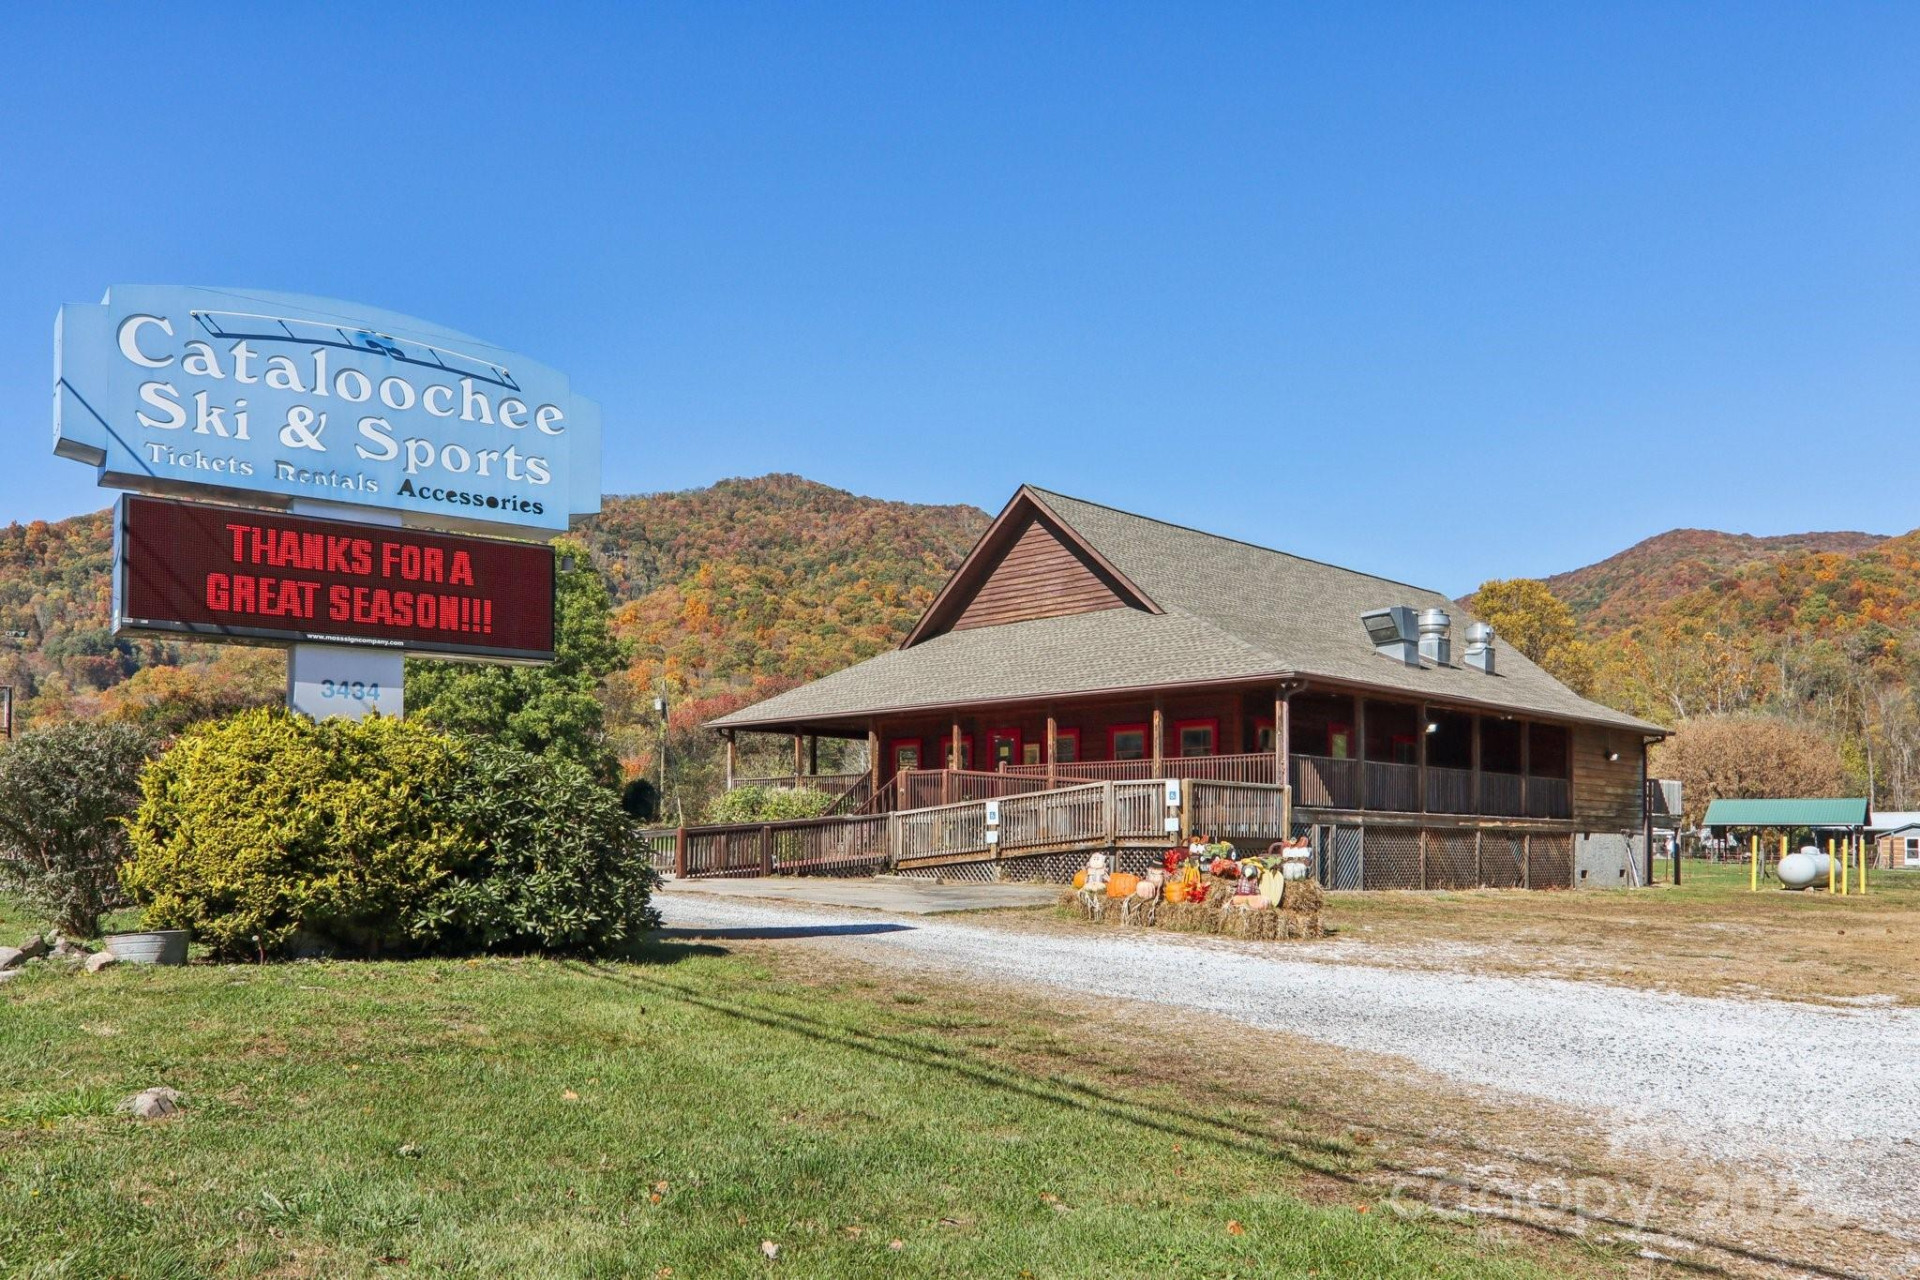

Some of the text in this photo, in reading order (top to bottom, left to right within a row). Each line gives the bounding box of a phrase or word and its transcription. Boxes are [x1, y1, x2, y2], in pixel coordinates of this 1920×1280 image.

[116, 313, 565, 436] Cataloochee
[136, 381, 552, 486] Ski & Sports
[144, 441, 545, 516] Tickets Rentals Accessories
[225, 523, 475, 587] THANKS FOR A
[206, 572, 493, 634] GREAT SEASON!!!
[320, 679, 381, 702] 3434
